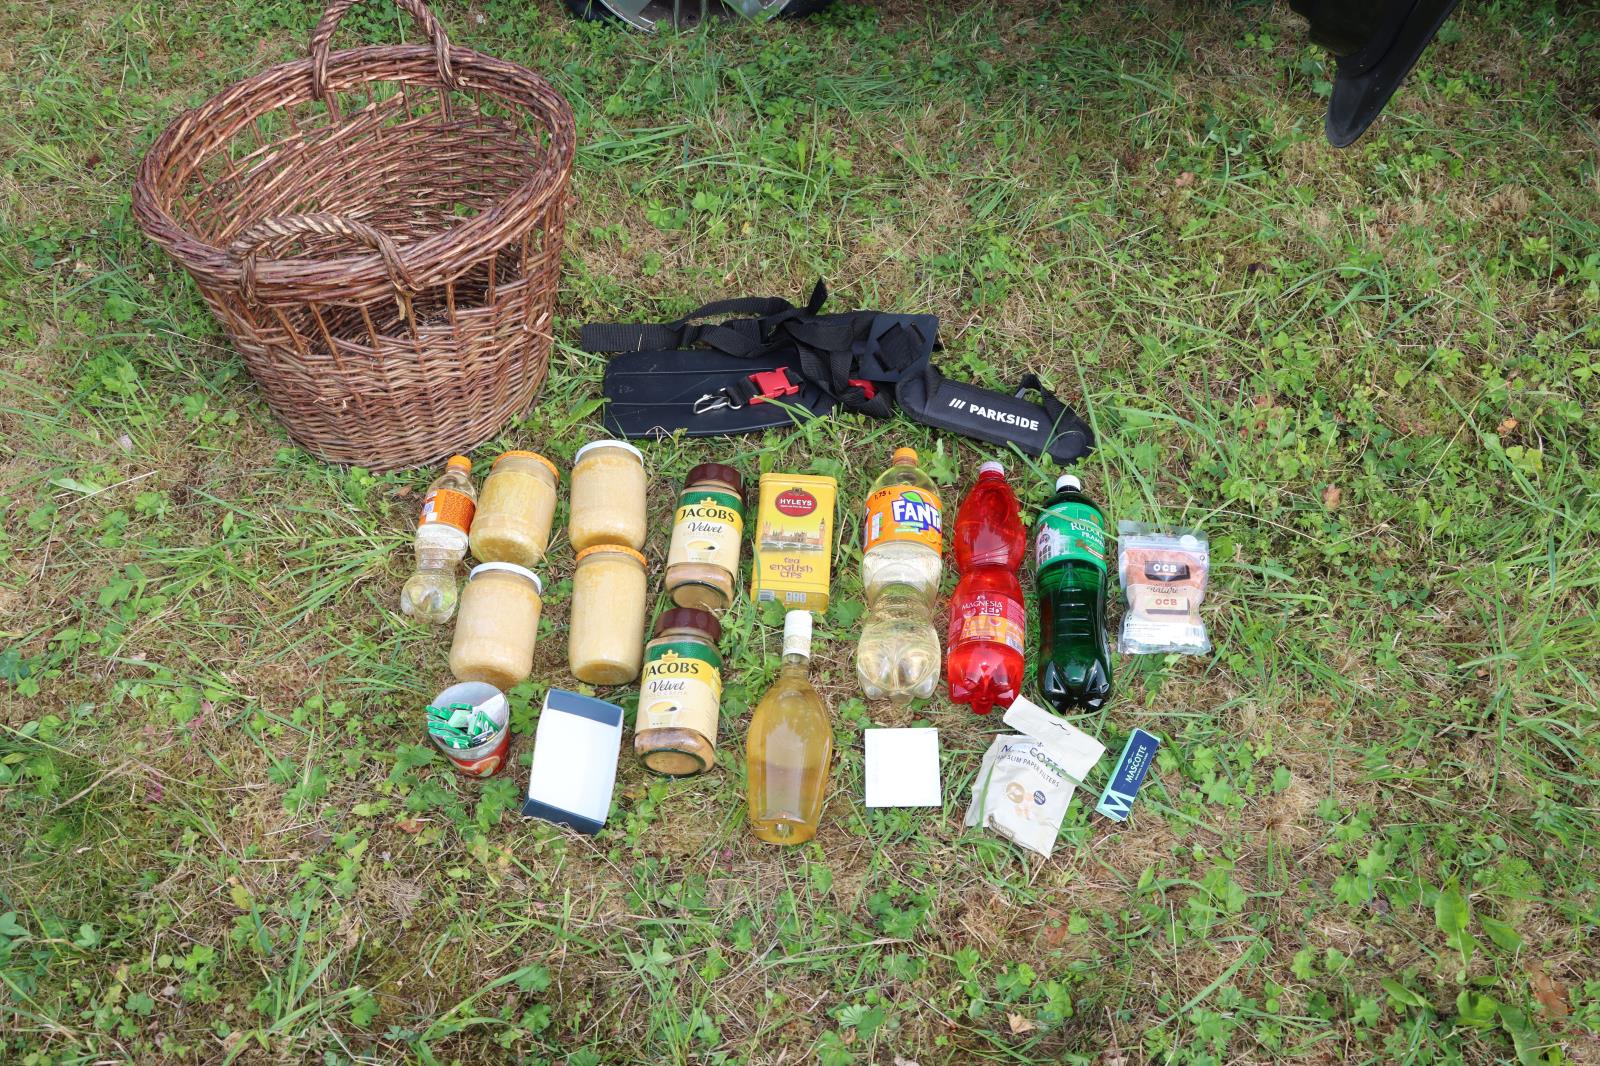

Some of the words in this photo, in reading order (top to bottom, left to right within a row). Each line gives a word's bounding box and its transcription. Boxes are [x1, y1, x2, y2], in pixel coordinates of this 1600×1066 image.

[969, 403, 1040, 431] PARKSIDE
[779, 498, 813, 507] HYLEYS
[680, 507, 735, 523] JACOBS
[688, 521, 723, 533] Velvet
[784, 556, 800, 564] tea
[769, 563, 813, 574] english
[1153, 563, 1177, 573] OCB
[962, 600, 1003, 610] MAGNESIA
[642, 662, 699, 682] JACOBS
[648, 680, 686, 693] Velvet
[1125, 745, 1147, 783] MASCOTTE
[1007, 754, 1022, 764] SLIM
[1023, 758, 1040, 771] PAPER
[1039, 769, 1060, 787] FILTERS
